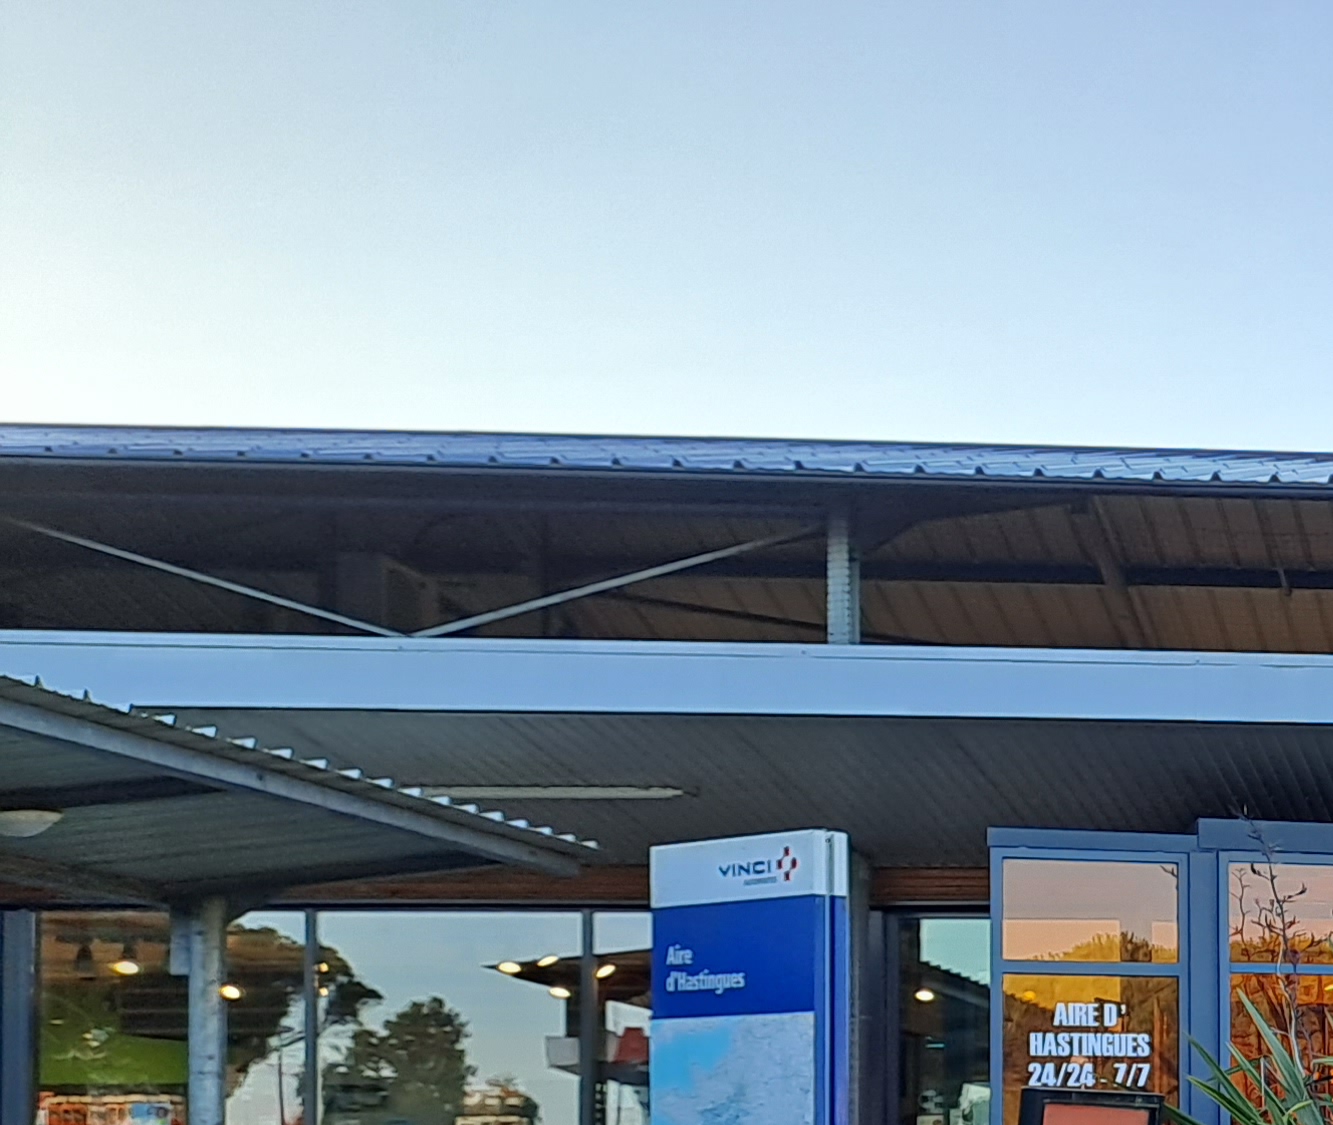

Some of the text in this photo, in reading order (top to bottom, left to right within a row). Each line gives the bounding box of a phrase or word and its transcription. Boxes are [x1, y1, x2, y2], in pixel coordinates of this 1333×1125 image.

[718, 860, 772, 877] VINCI
[665, 944, 694, 966] Aire
[665, 969, 746, 994] d'Hastingues
[1053, 1002, 1099, 1027] AIRE
[1029, 1032, 1152, 1057] HASTINGUES
[1027, 1062, 1096, 1087] 24/24
[1113, 1063, 1151, 1088] 7/7
